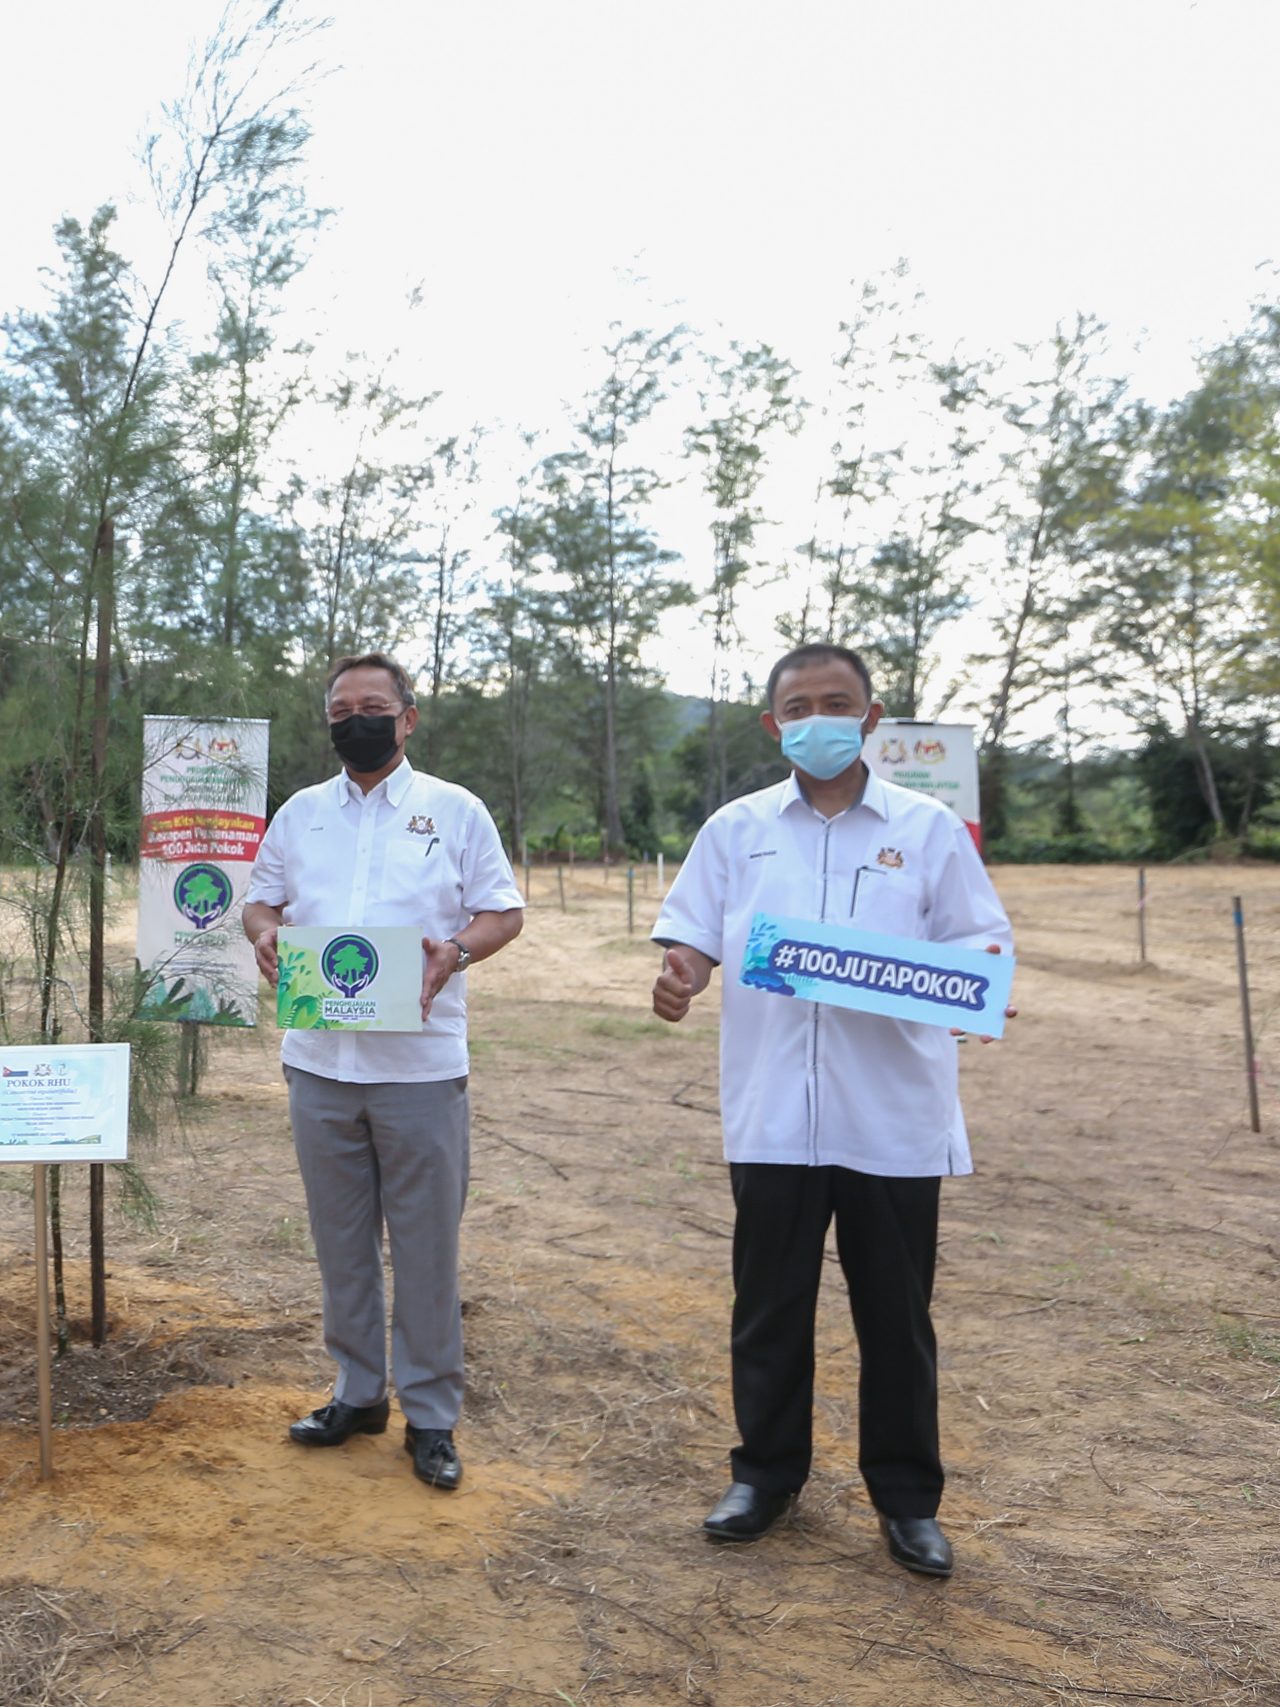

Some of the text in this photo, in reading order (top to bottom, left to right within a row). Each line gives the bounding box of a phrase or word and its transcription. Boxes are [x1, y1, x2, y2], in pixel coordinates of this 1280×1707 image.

[184, 841, 208, 855] Juta
[209, 840, 245, 856] Pokok
[774, 943, 982, 1005] #100JUTAPOKOK
[325, 1006, 376, 1015] MALAYSIA
[6, 1078, 71, 1088] POKOK RHU
